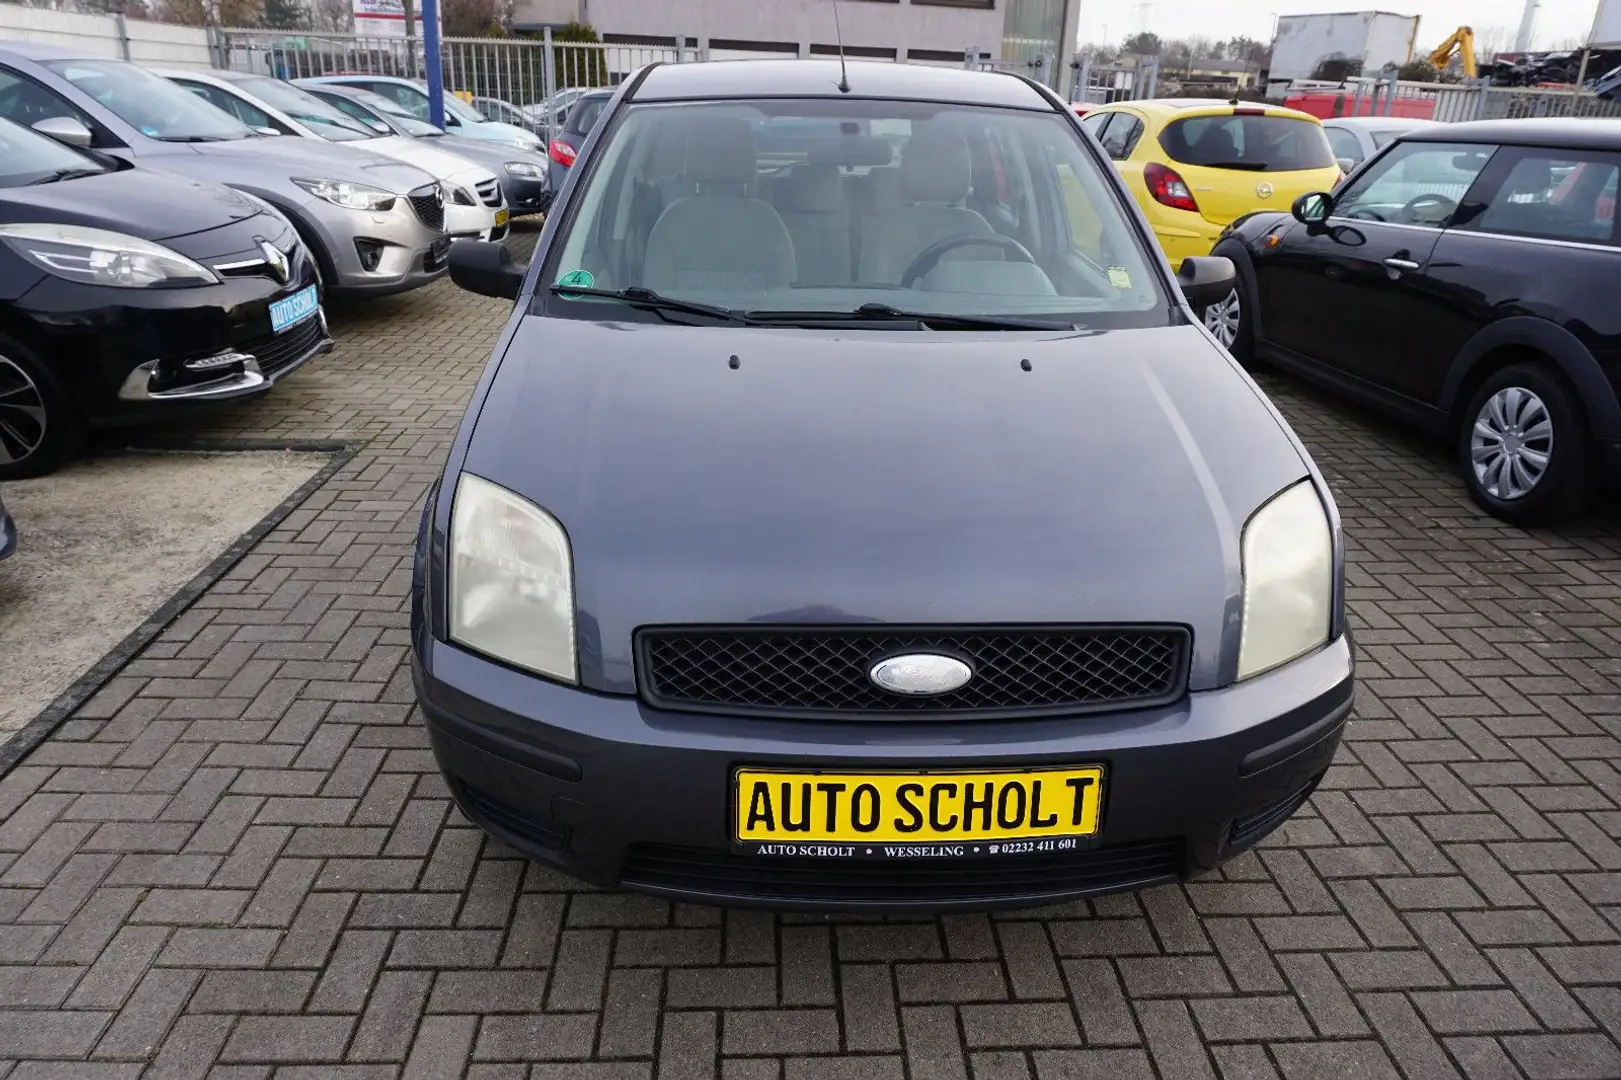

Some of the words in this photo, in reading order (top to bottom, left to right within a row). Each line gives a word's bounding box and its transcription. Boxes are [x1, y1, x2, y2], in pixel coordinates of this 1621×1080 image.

[571, 271, 582, 285] 4
[271, 301, 294, 326] AUTO
[746, 781, 881, 832] AUTO
[894, 777, 1094, 833] SCHOLT
[757, 844, 796, 856] AUTO
[799, 845, 855, 857] SCHOLT
[884, 846, 964, 857] WESSELING
[1002, 842, 1034, 854] 02232
[1037, 840, 1054, 852] 411
[1058, 838, 1076, 851] 601
